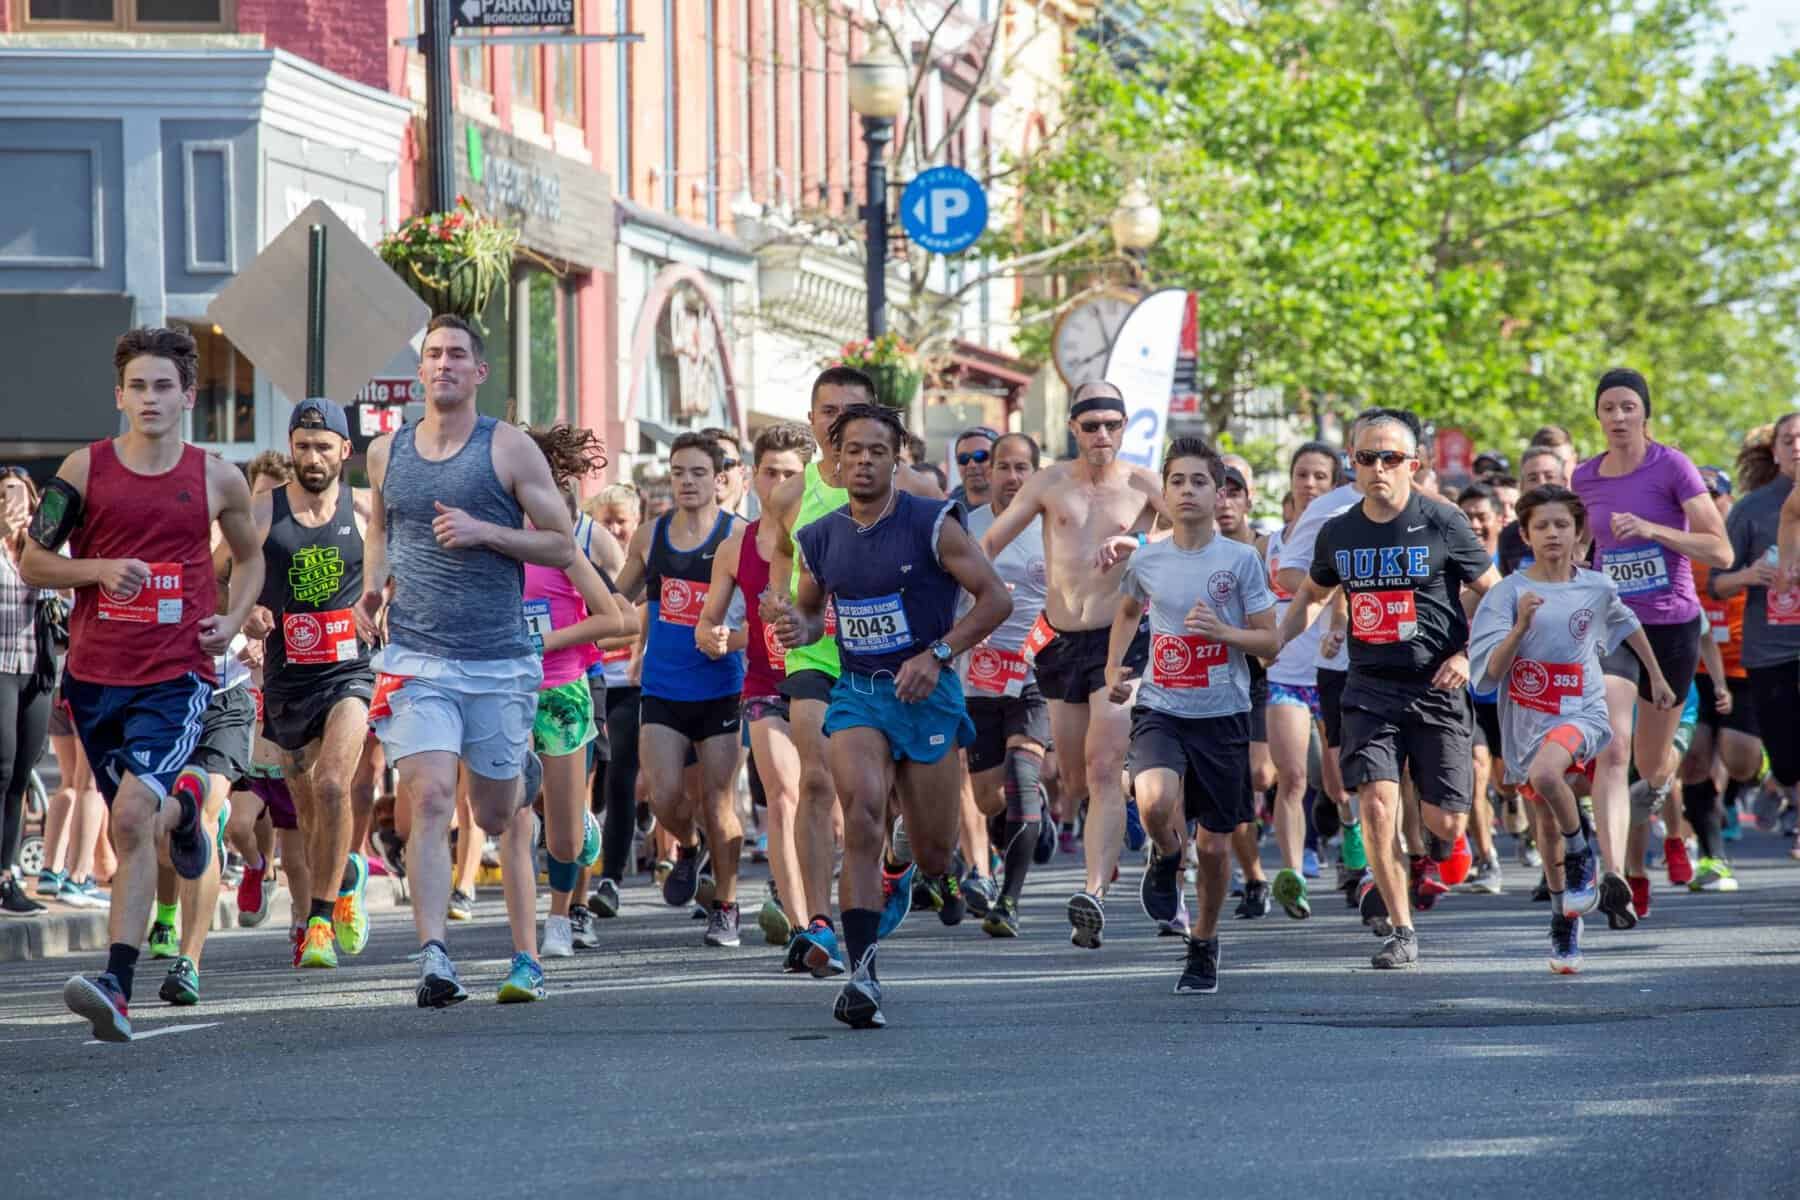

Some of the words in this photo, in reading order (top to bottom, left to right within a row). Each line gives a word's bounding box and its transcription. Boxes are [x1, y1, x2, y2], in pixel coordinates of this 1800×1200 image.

[482, 0, 572, 12] PARKING
[483, 12, 539, 24] BOROUGH
[541, 12, 570, 23] LOTS
[1335, 546, 1430, 580] DUKE
[1609, 560, 1657, 581] 2050
[145, 575, 180, 590] 1181
[1349, 579, 1376, 588] TRACK
[1377, 578, 1384, 586] &
[1386, 577, 1411, 586] FIELD
[1386, 600, 1410, 615] 507
[325, 620, 349, 634] 597
[847, 615, 897, 638] 2043
[1196, 643, 1222, 659] 277
[1553, 673, 1579, 687] 353
